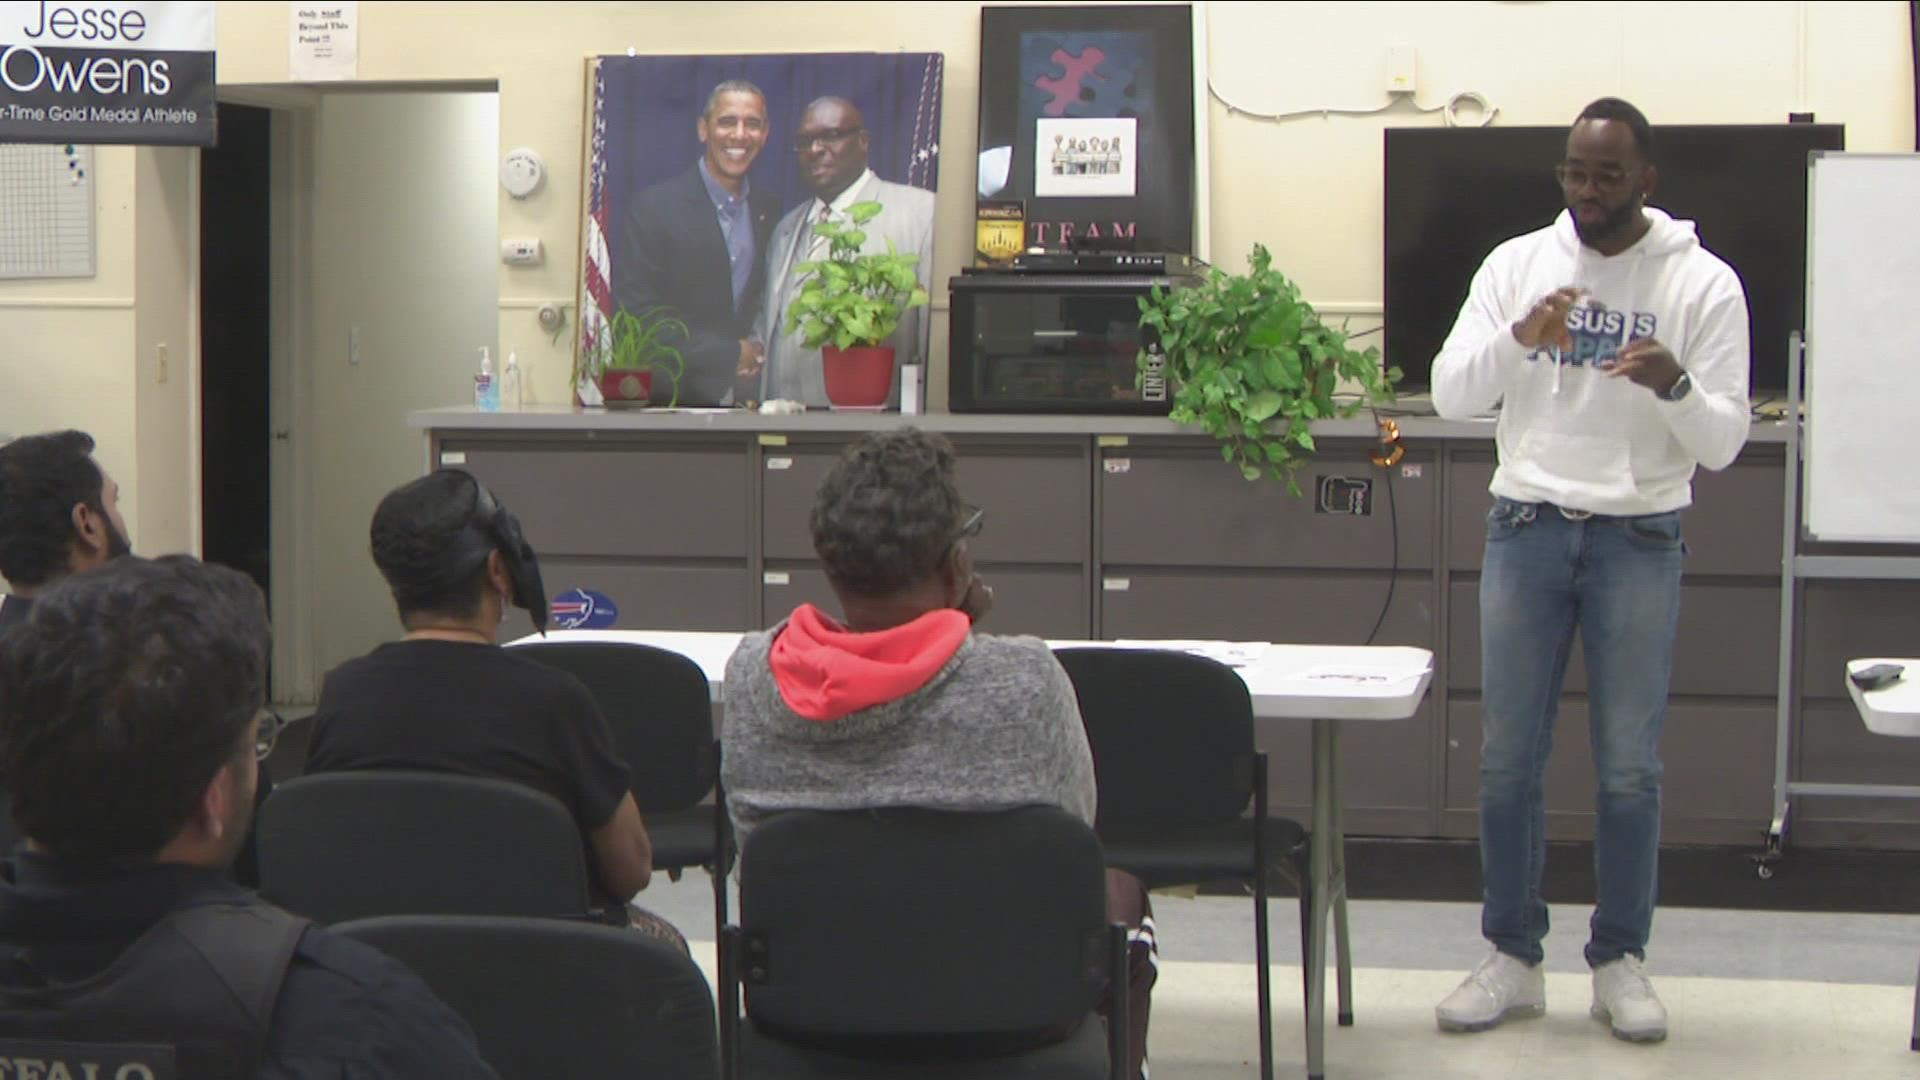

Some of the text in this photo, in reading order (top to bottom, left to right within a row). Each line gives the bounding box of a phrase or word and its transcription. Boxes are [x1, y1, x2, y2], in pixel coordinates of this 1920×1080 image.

[24, 1, 146, 41] Jesse
[298, 22, 349, 32] Beyond This
[298, 35, 320, 44] Point
[0, 45, 171, 95] Owens
[49, 105, 87, 122] Gold
[91, 106, 138, 123] Medal
[142, 106, 197, 124] Athlete
[1031, 222, 1137, 245] TEAM
